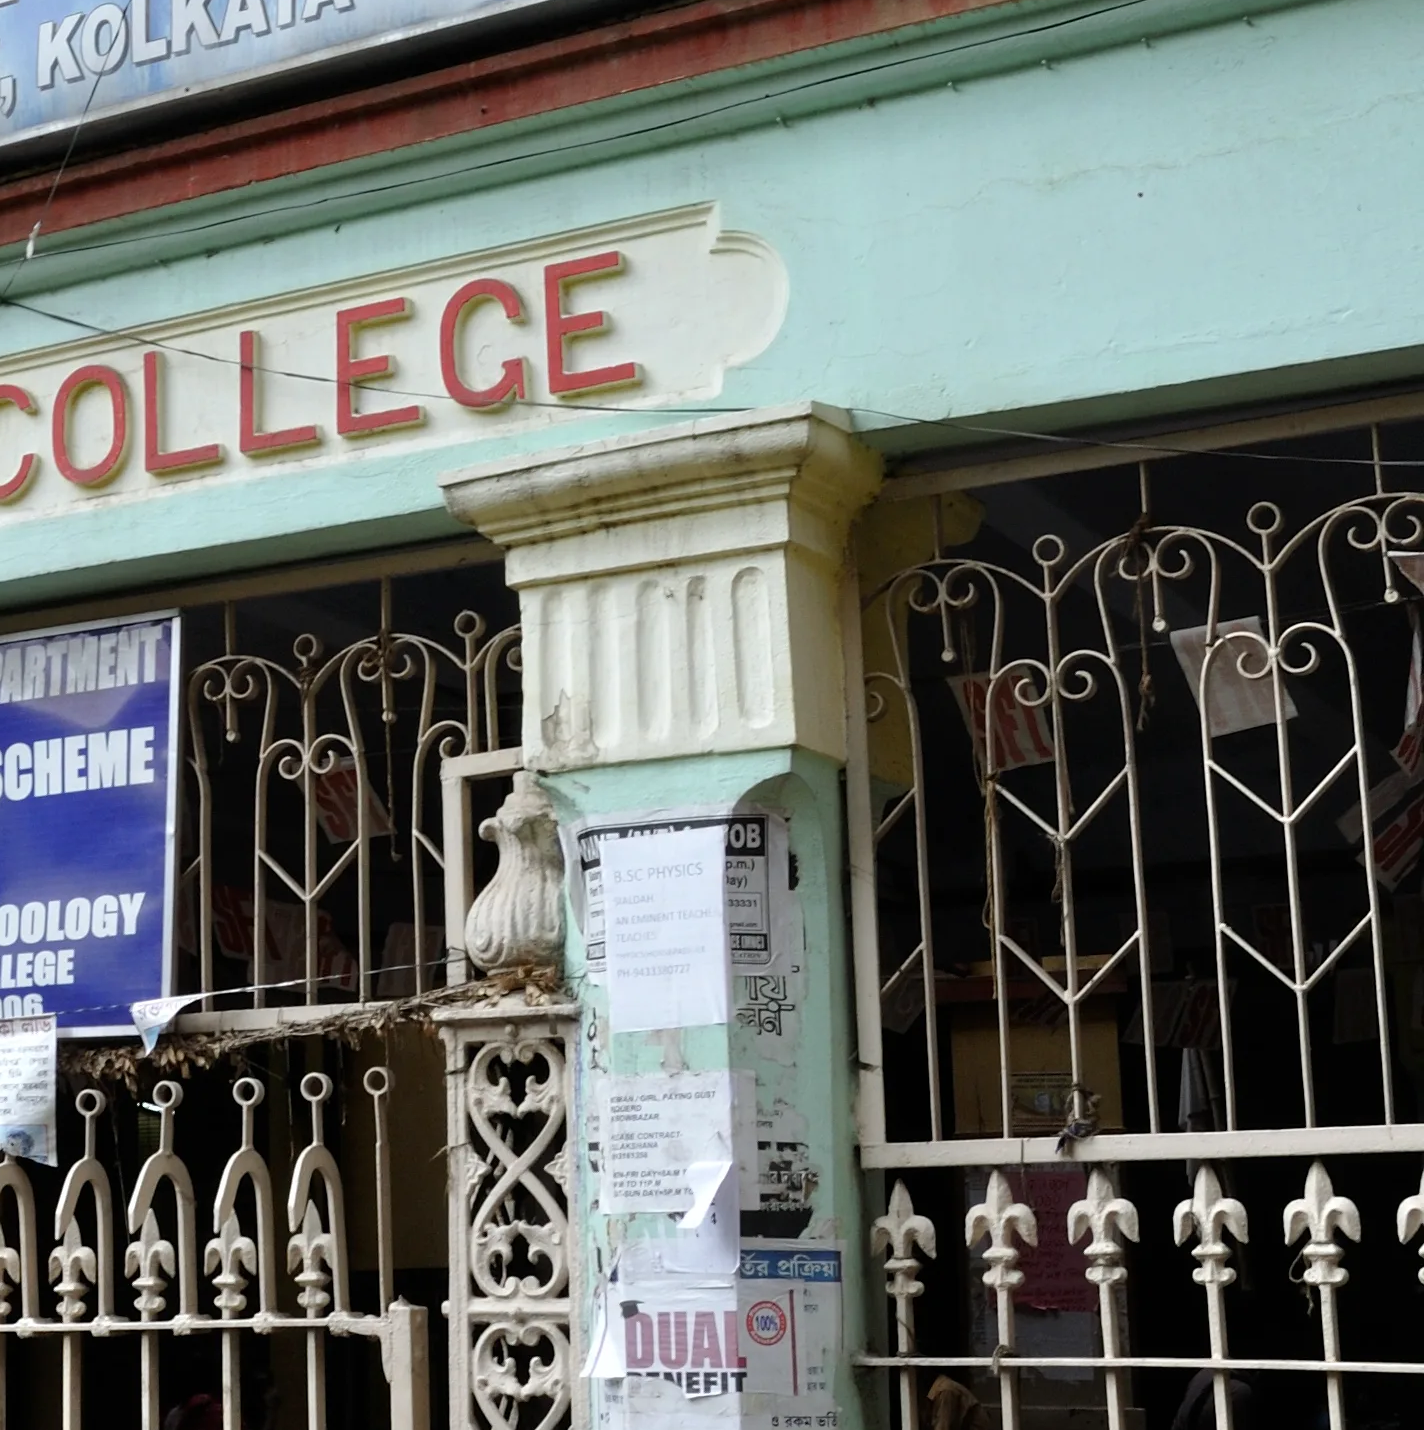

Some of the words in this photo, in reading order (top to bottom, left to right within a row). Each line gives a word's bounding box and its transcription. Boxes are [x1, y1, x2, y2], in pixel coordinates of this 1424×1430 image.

[725, 822, 762, 849] OB
[614, 868, 643, 883] B.SC
[648, 861, 704, 879] PHYSICS
[776, 1253, 839, 1278] প্রক্রিয়া
[625, 1310, 747, 1369] DUAL
[625, 1371, 748, 1394] EFIT
